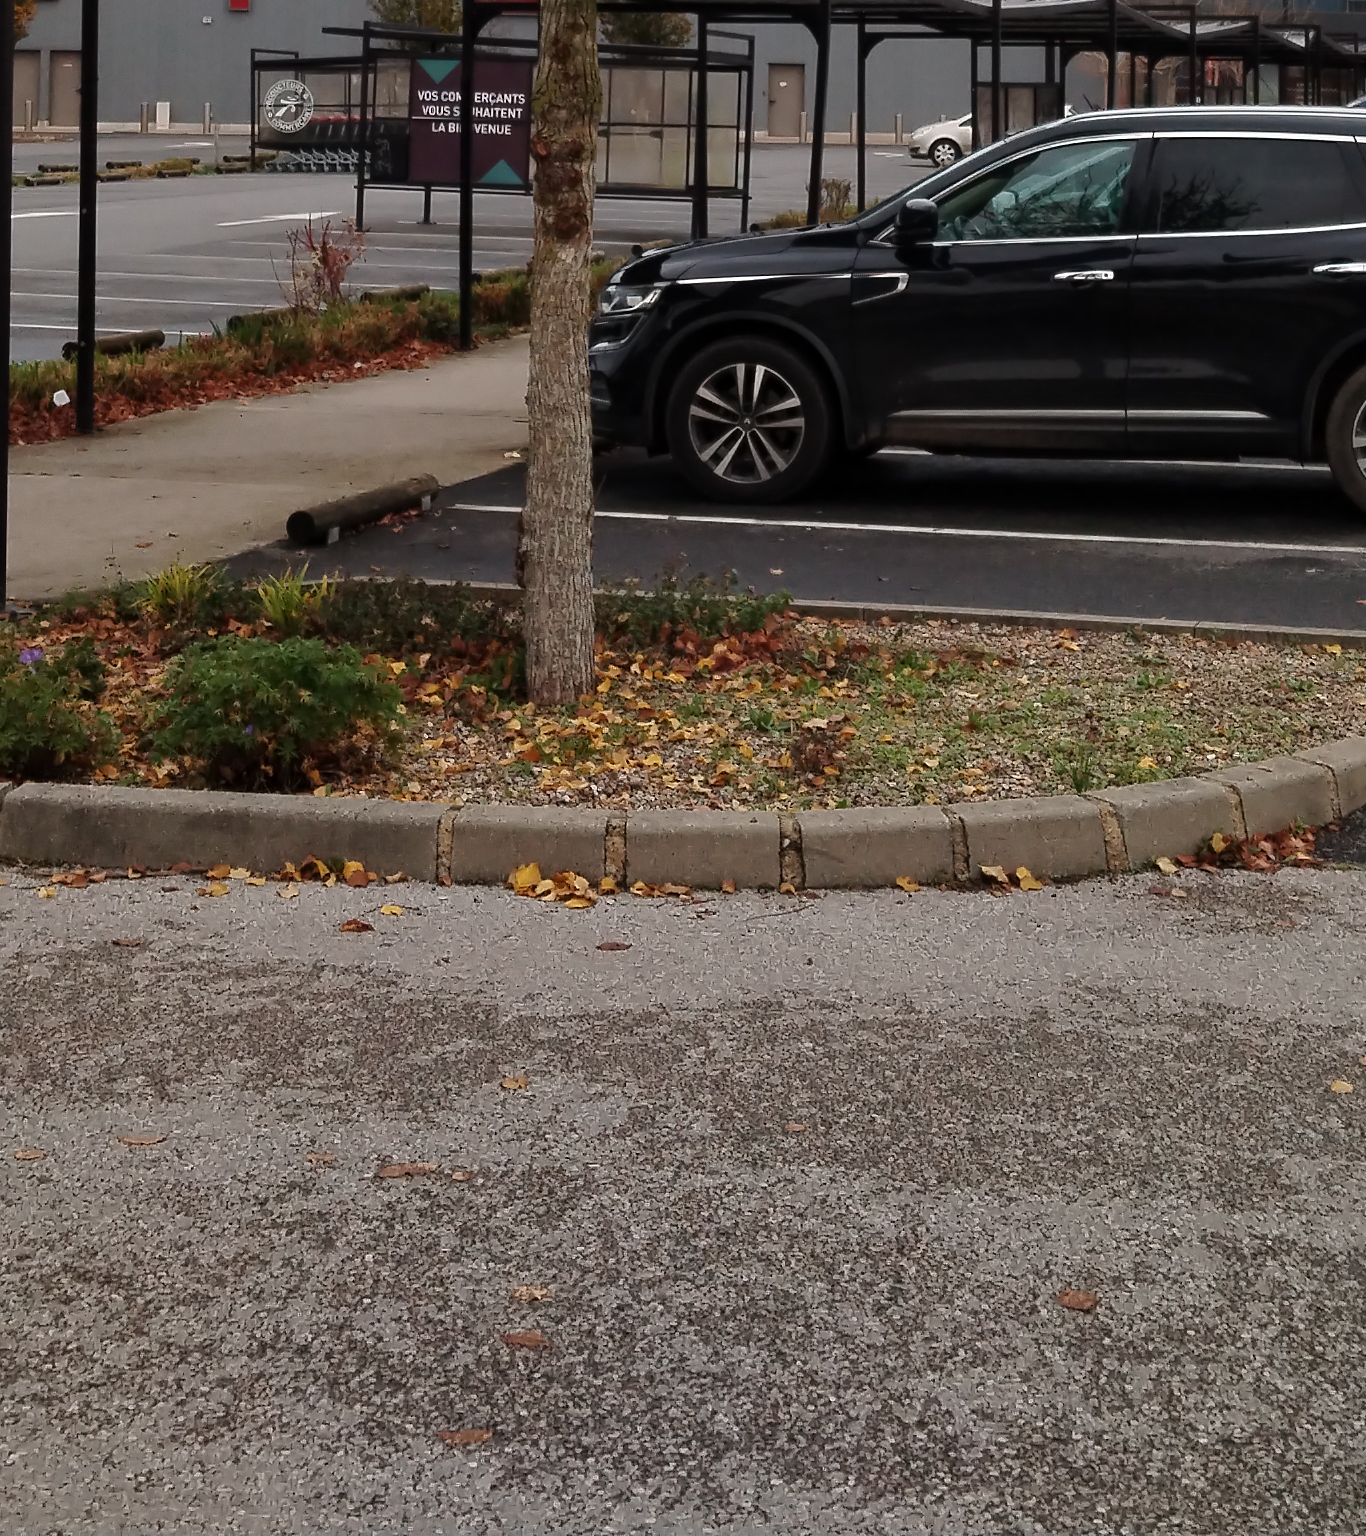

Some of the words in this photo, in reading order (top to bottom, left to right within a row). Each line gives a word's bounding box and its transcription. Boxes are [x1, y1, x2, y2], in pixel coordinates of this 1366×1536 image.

[418, 90, 438, 101] VOS
[441, 91, 526, 105] COMERÇANTS
[422, 105, 450, 116] VOUS
[431, 122, 446, 133] LA
[449, 122, 512, 135] BIVENUE
